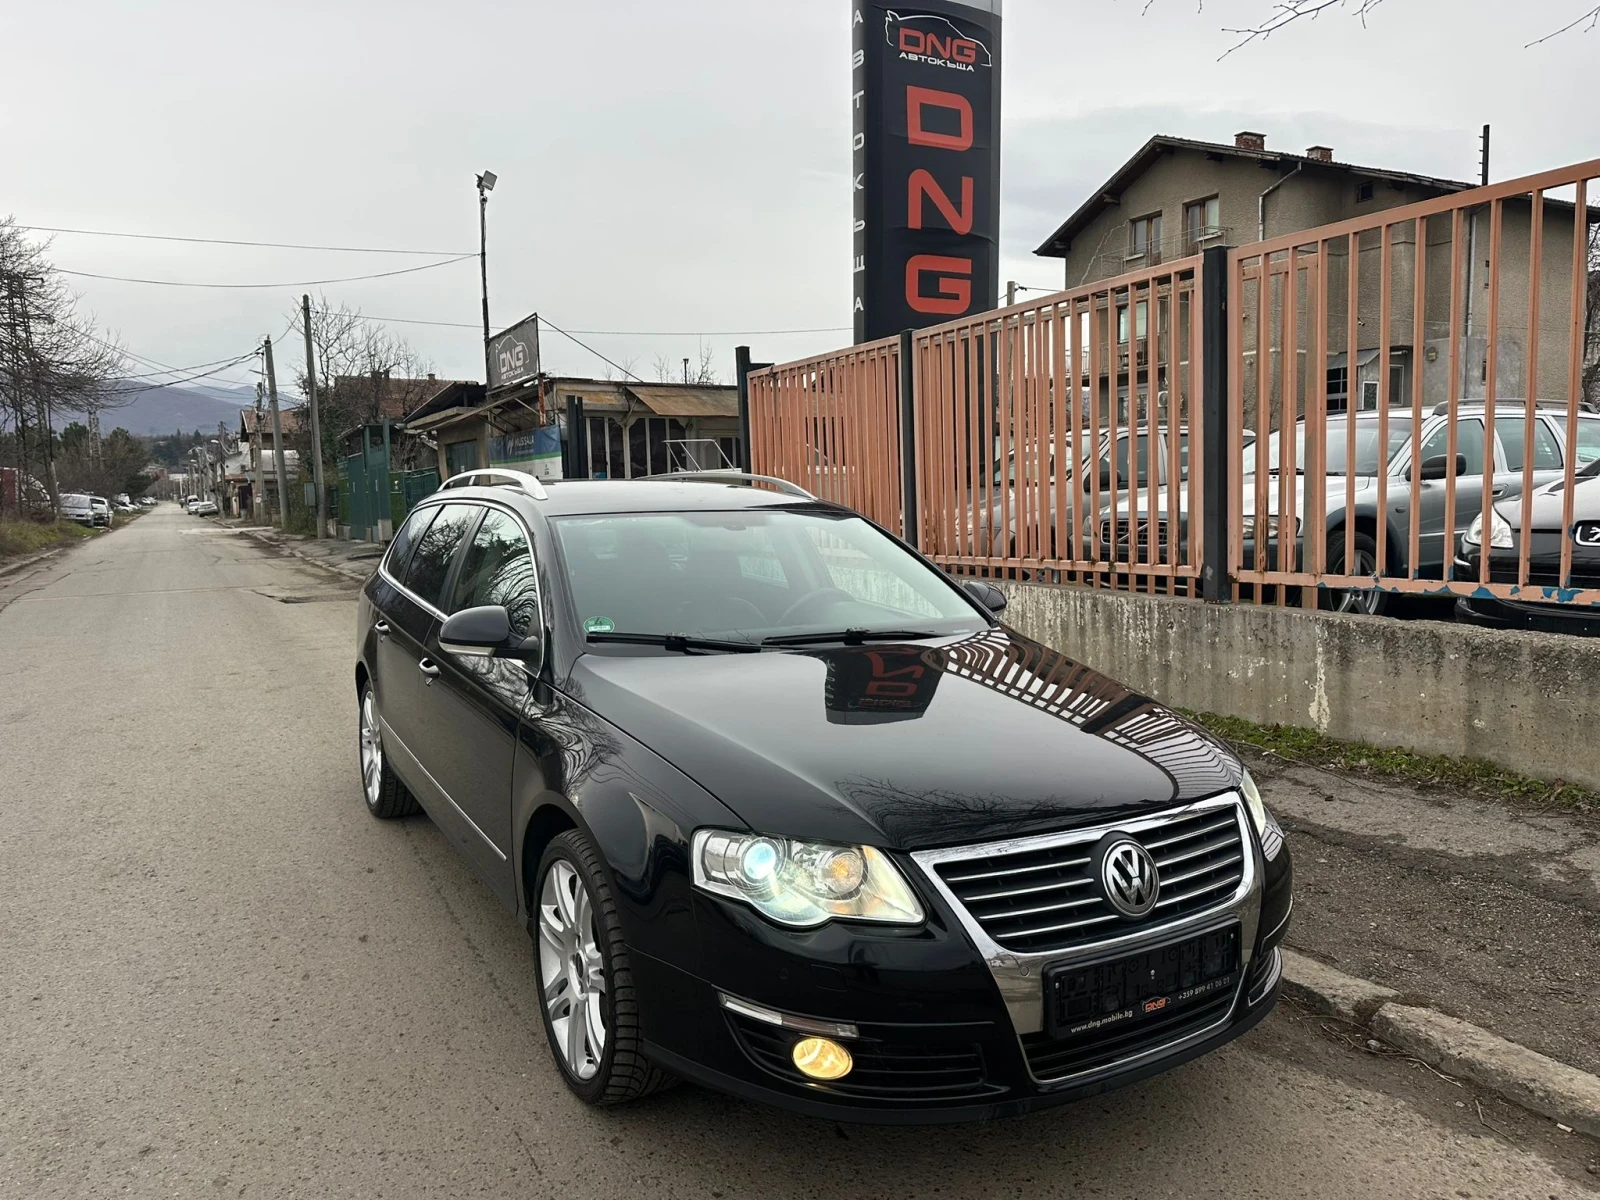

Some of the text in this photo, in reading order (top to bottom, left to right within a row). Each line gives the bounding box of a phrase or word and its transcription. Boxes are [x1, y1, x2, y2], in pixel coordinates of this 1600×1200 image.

[899, 27, 976, 64] DNG
[899, 51, 975, 72] АВТОКЪЩА
[905, 85, 974, 315] DNG
[500, 345, 524, 373] DNG
[1178, 989, 1193, 1000] +359
[1194, 985, 1206, 995] 899
[1206, 982, 1214, 990] 41
[1145, 998, 1167, 1011] DNG
[1070, 1010, 1133, 1033] www.dng.mobile.bg
